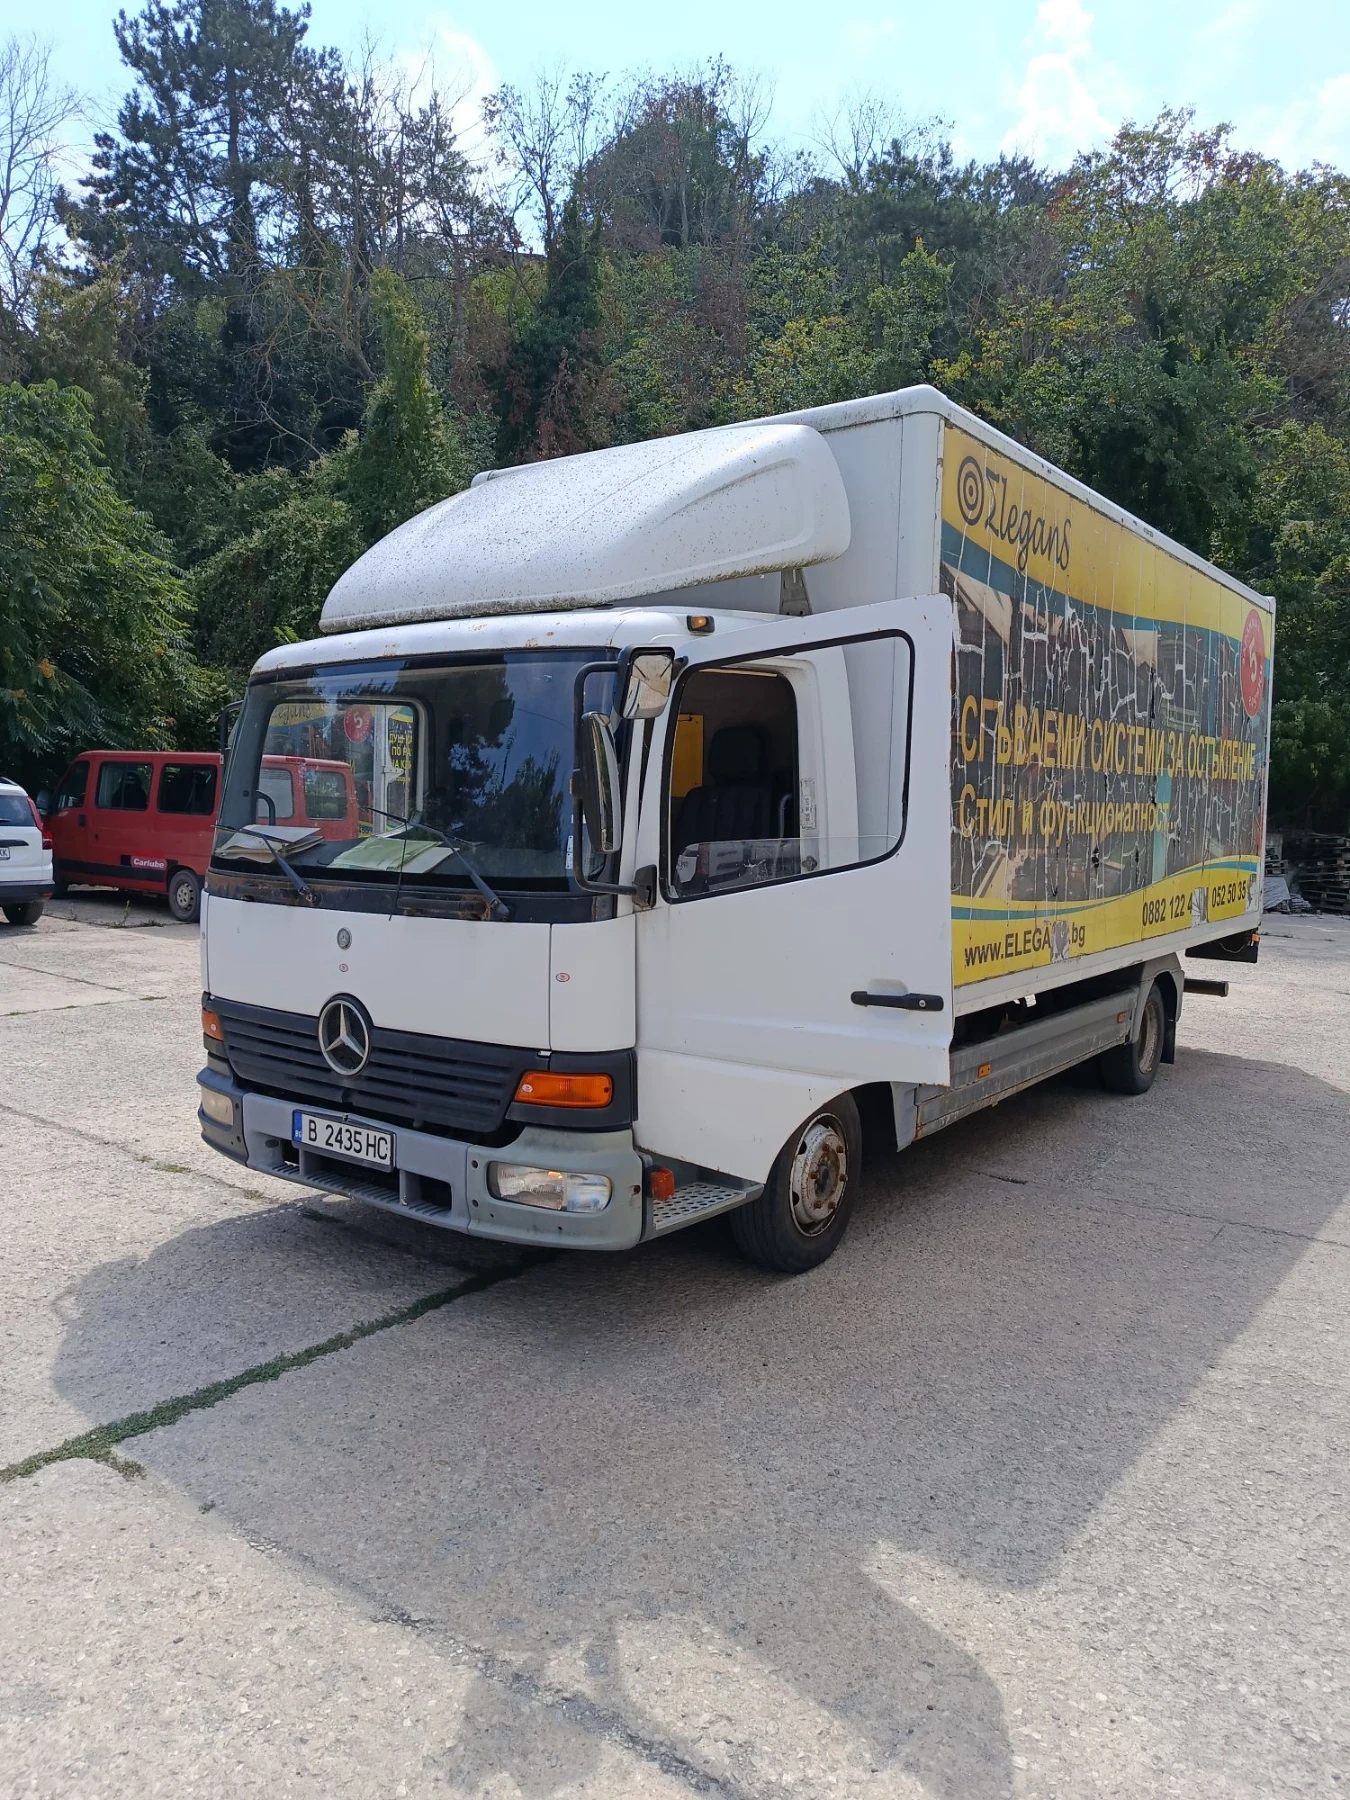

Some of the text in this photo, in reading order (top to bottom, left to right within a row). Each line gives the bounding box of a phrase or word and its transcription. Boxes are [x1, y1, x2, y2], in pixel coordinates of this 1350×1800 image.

[1249, 637, 1258, 682] 5
[960, 695, 1257, 780] СГЪВАЕМИ СИСТЕМИ ЗА ОСТЪКЛЕНИЕ
[959, 783, 1015, 838] Стил
[133, 858, 165, 869] Carlube
[1142, 898, 1167, 927] 0882
[1169, 893, 1186, 920] 122
[1211, 880, 1247, 908] 052 50 35
[964, 922, 1086, 967] www.ELEGA.bg
[308, 1119, 388, 1160] B 2435 HC
